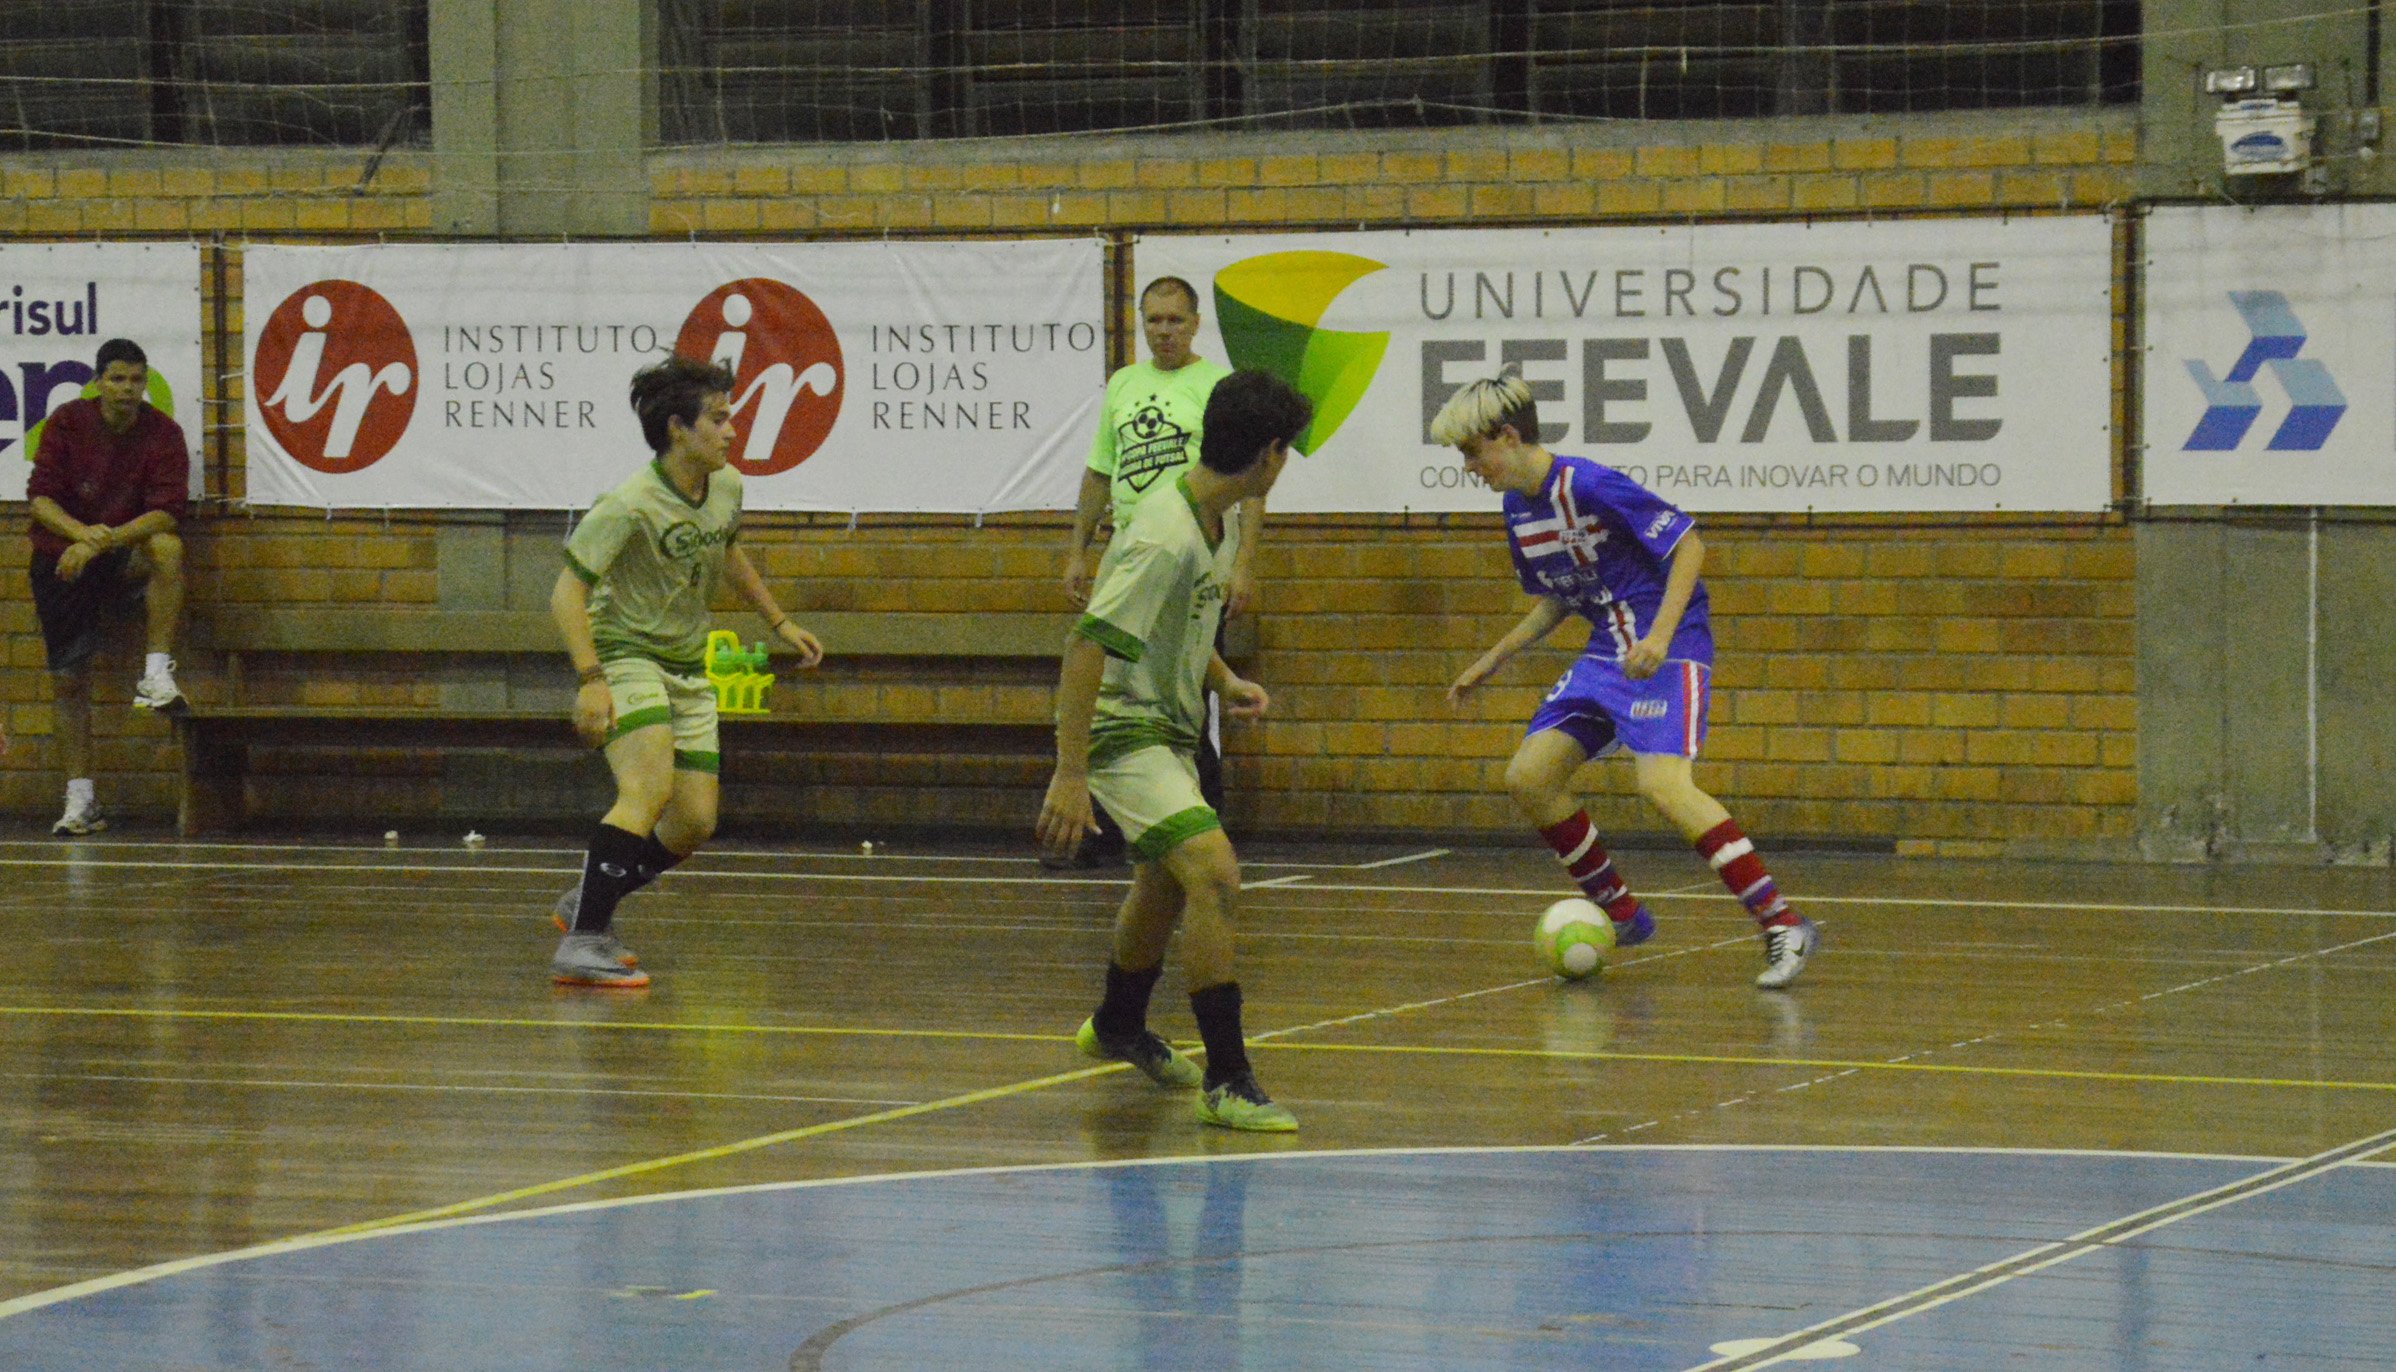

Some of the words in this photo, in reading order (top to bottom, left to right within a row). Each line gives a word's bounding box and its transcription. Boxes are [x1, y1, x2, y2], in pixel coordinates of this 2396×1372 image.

[1420, 263, 2002, 320] UNIVERSIDADE
[444, 324, 657, 353] INSTITUTO
[872, 322, 1096, 353] INSTITUTO
[444, 361, 555, 394] LOJAS
[872, 361, 988, 395] LOJAS
[1421, 331, 2005, 444] FEEVALE
[444, 400, 597, 428] RENNER
[872, 401, 1032, 430] RENNER
[1656, 464, 1733, 488] PARA
[1740, 463, 1849, 488] INOVAR
[1856, 463, 1879, 488] O
[1887, 462, 2002, 488] MUNDO
